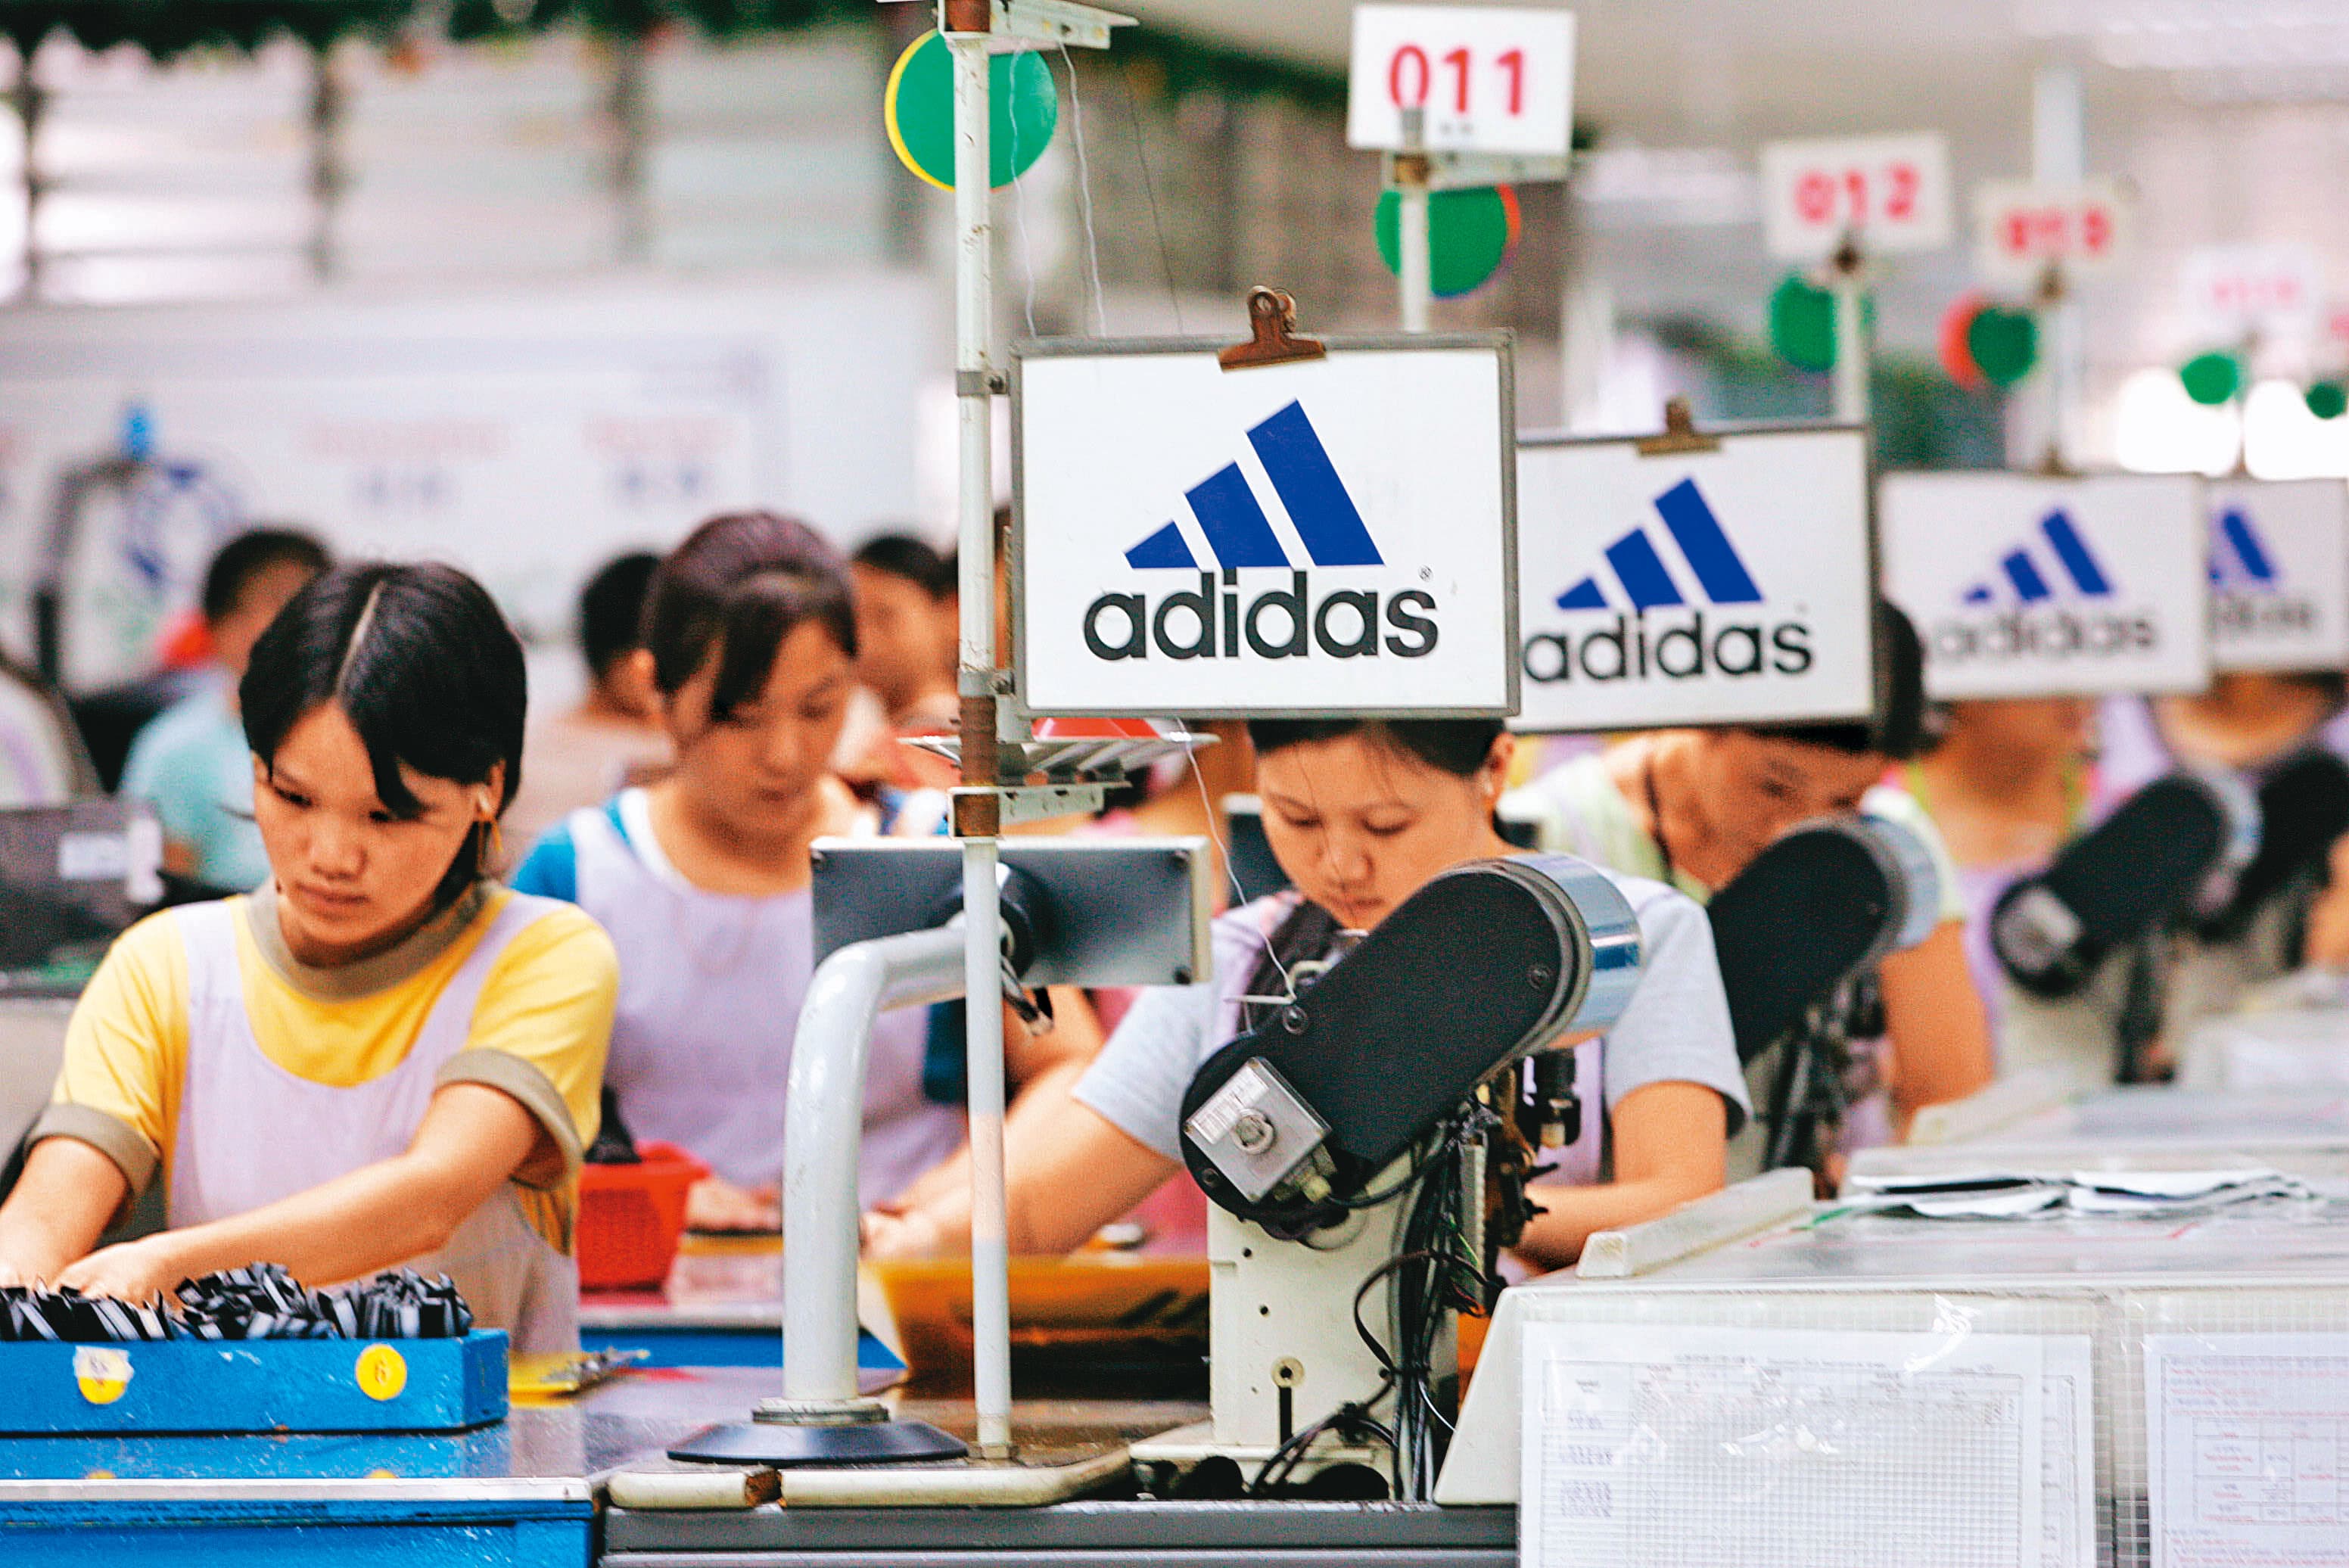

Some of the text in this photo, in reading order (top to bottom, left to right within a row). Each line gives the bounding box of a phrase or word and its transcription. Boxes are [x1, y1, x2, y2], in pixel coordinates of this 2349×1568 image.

[1389, 44, 1523, 116] 011
[1791, 160, 1921, 225] 012
[1083, 568, 1439, 661] adidas
[1523, 606, 1813, 683] adidas
